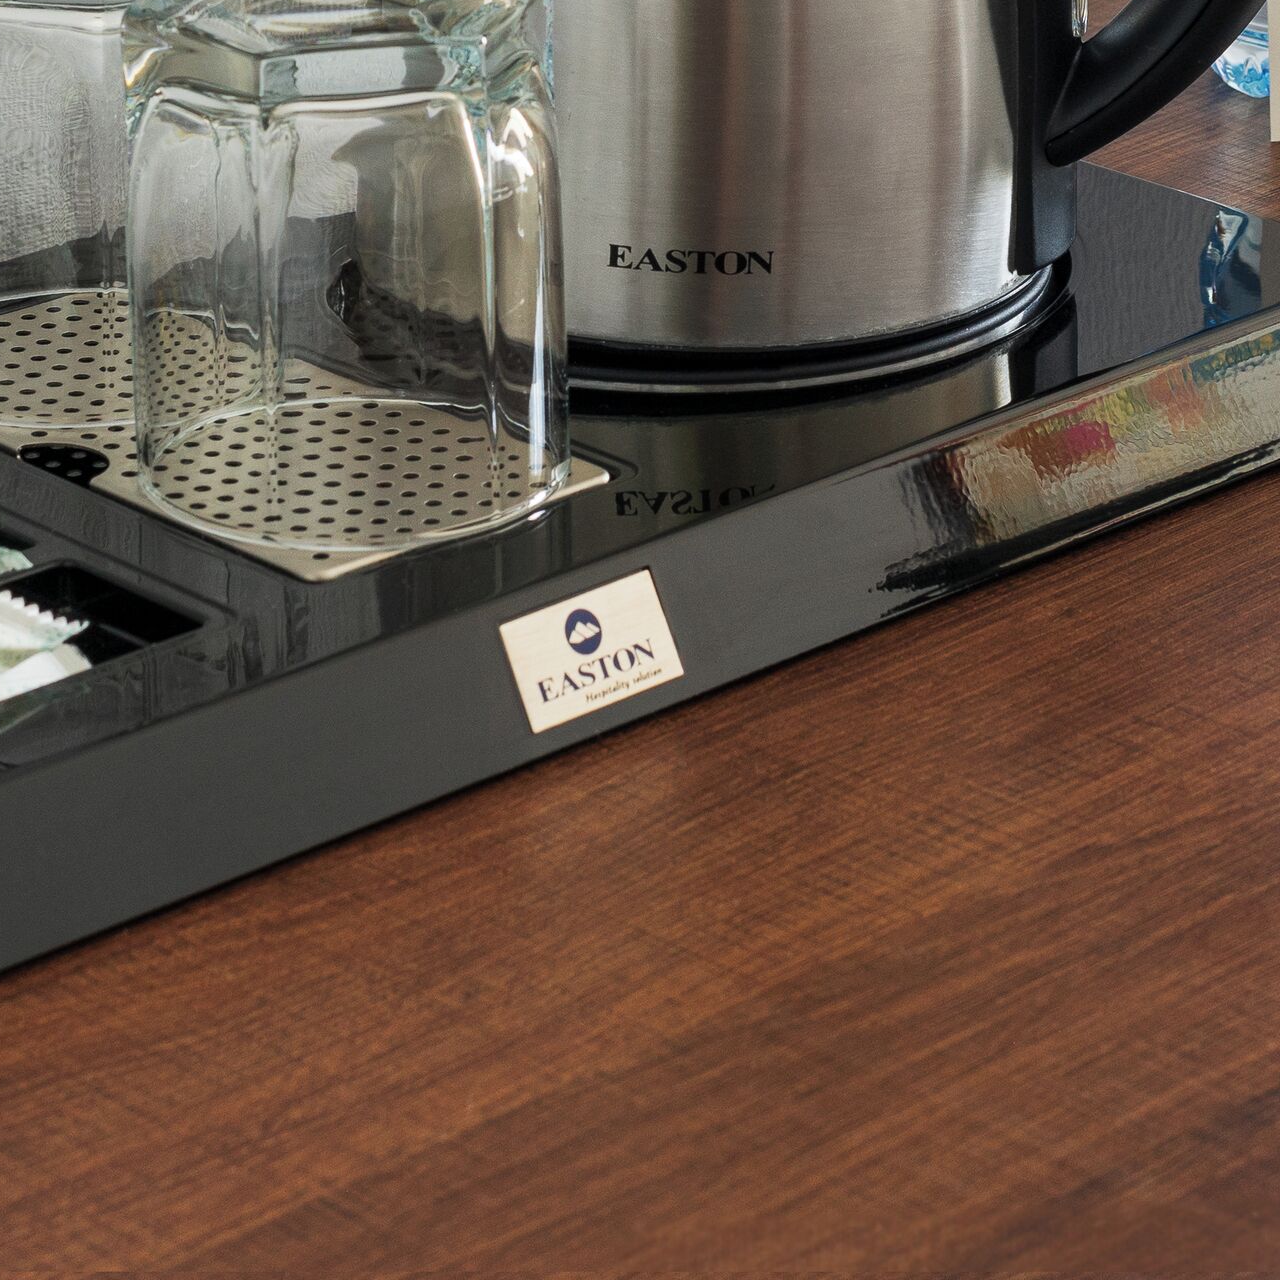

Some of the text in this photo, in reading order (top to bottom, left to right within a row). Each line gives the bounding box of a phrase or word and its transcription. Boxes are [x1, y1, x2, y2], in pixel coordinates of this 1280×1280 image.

[607, 243, 775, 275] EASTON
[538, 638, 655, 704] EASTON
[585, 667, 663, 704] Hospitality solution
